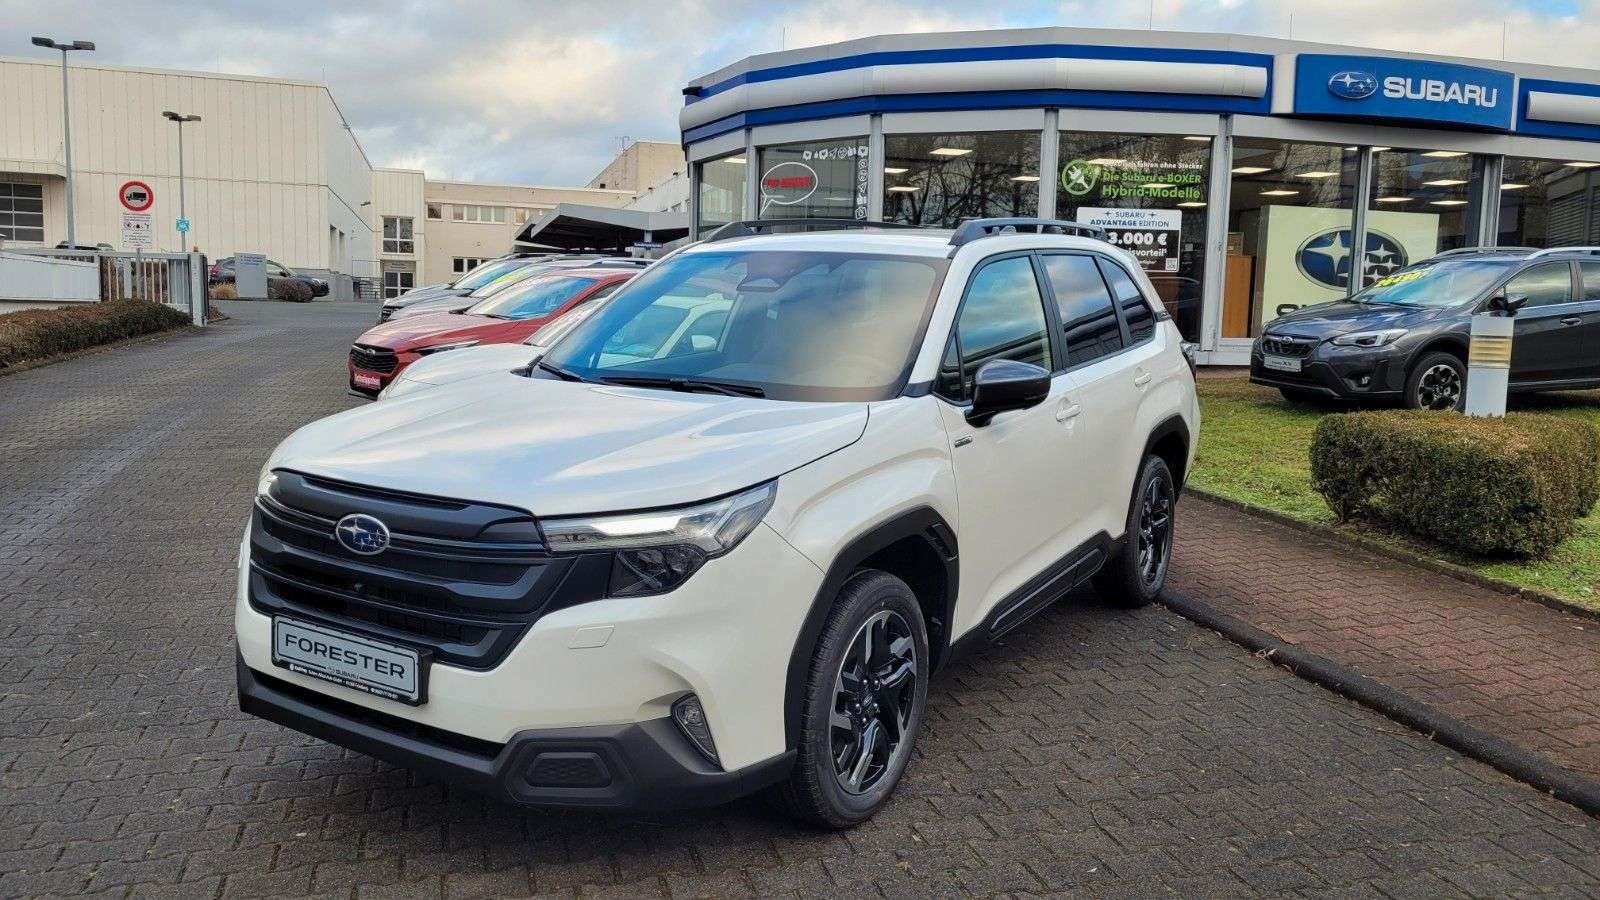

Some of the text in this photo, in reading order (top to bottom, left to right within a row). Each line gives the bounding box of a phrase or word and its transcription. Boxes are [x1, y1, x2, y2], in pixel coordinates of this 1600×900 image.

[1383, 76, 1498, 108] SUBARU
[1103, 172, 1201, 183] Die Subaru e-BOXER
[1102, 185, 1201, 199] Hybrid-Modelle
[1115, 211, 1146, 219] SUBARU
[1138, 220, 1169, 228] EDITION
[1107, 231, 1168, 246] 3.000 €
[284, 633, 405, 679] FORESTER
